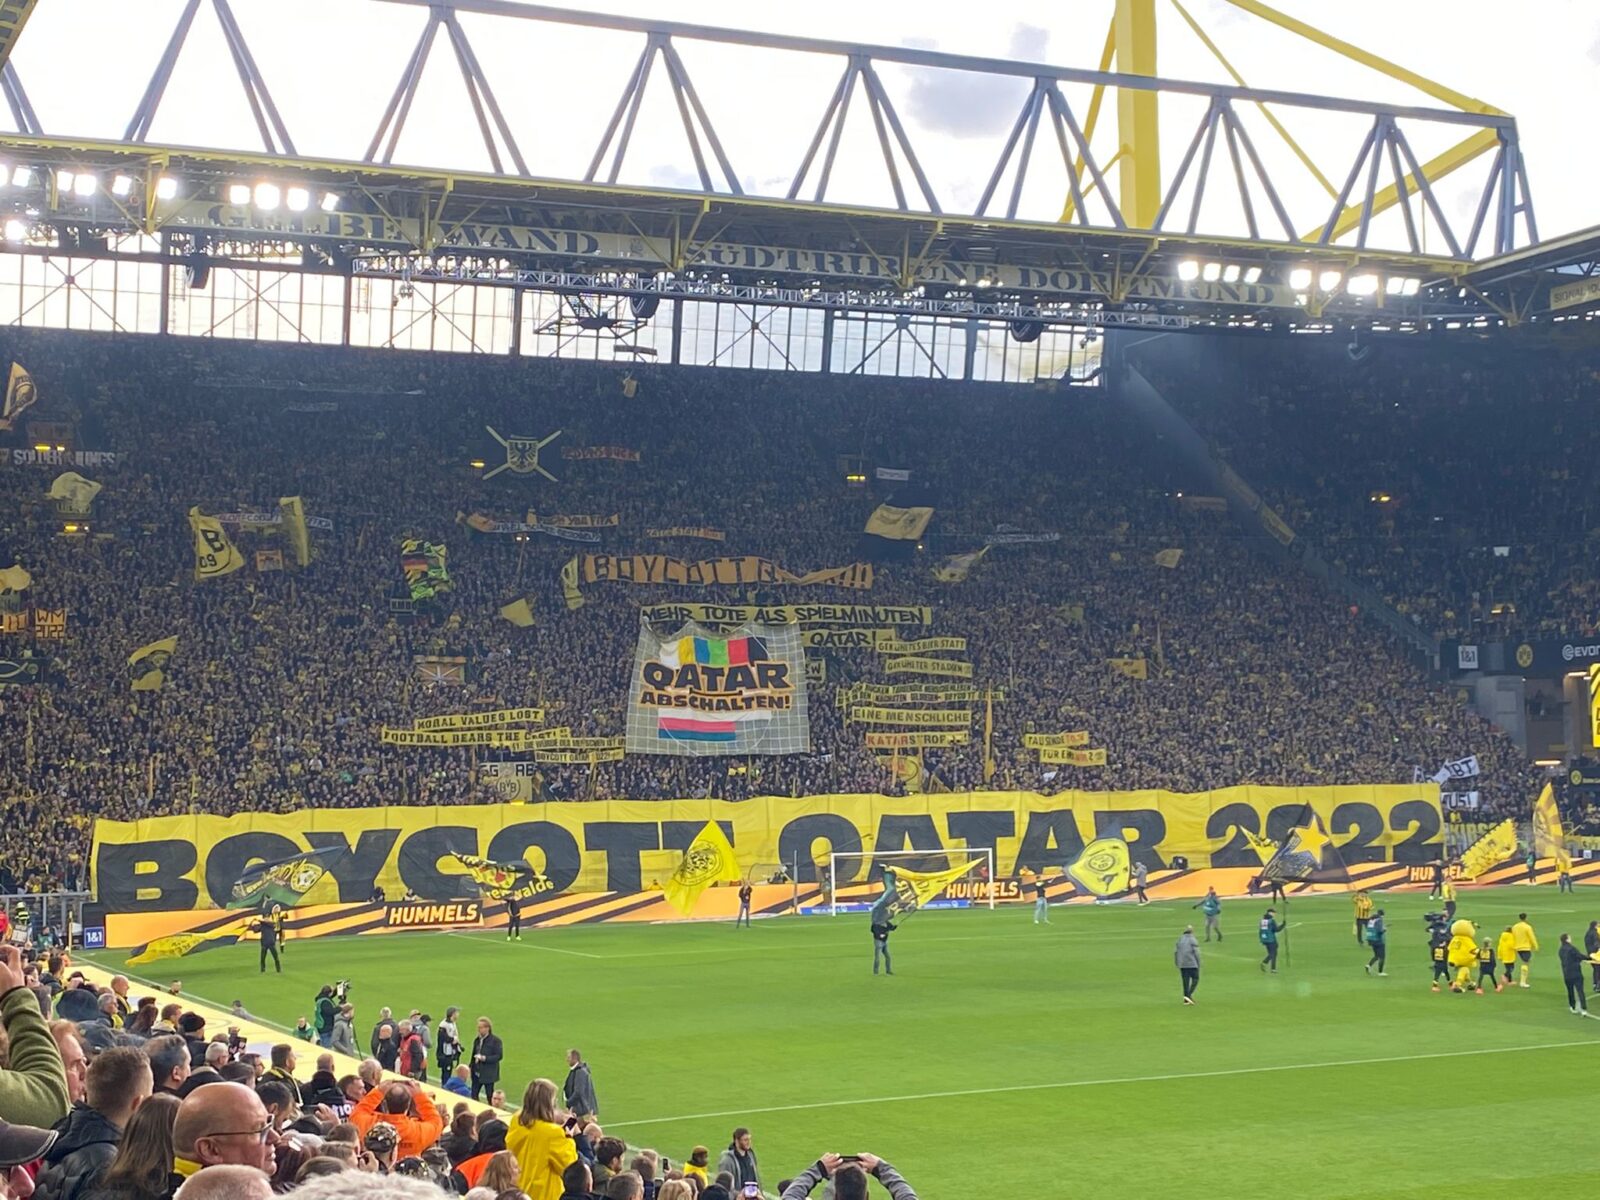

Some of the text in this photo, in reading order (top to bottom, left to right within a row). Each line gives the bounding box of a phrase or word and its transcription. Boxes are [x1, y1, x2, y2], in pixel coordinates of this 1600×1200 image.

[439, 221, 599, 255] WAND
[37, 608, 65, 623] WM
[642, 605, 924, 624] MEHR TOTE ALS SPIELMINUTEN
[810, 630, 877, 647] QATAR!
[940, 638, 964, 648] STATT
[643, 661, 792, 692] QATAR
[641, 692, 791, 711] ABSCHALTEN!
[417, 716, 456, 730] MORAL
[461, 712, 506, 726] VALUES
[853, 708, 970, 723] EINE MENSCHLICHE
[383, 730, 448, 744] FOOTBALL
[452, 731, 493, 744] BEARS
[496, 730, 520, 742] THE
[778, 808, 1168, 884] QATAR
[388, 902, 479, 926] HUMMELS
[86, 929, 104, 944] 1&1
